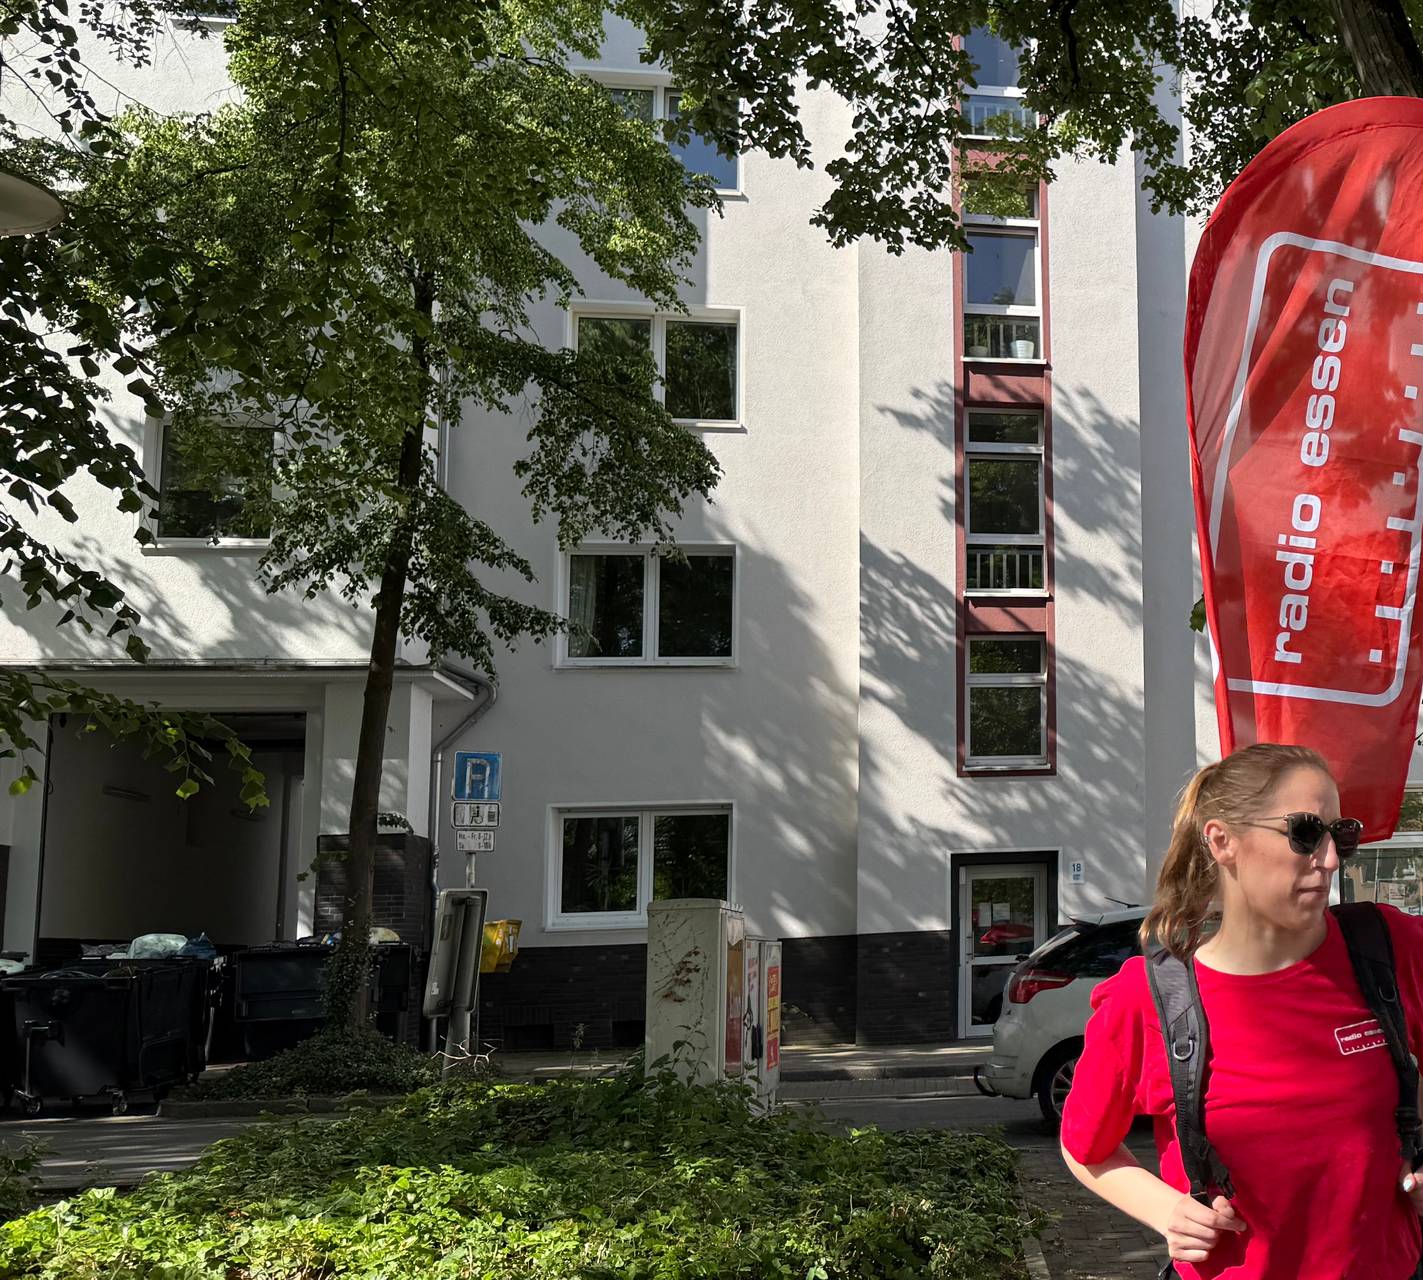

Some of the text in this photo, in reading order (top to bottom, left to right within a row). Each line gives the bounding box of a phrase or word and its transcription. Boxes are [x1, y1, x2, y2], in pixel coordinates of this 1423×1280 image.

[1274, 278, 1354, 664] radio essen
[1072, 863, 1081, 872] 18
[1340, 1028, 1384, 1042] radio esse
